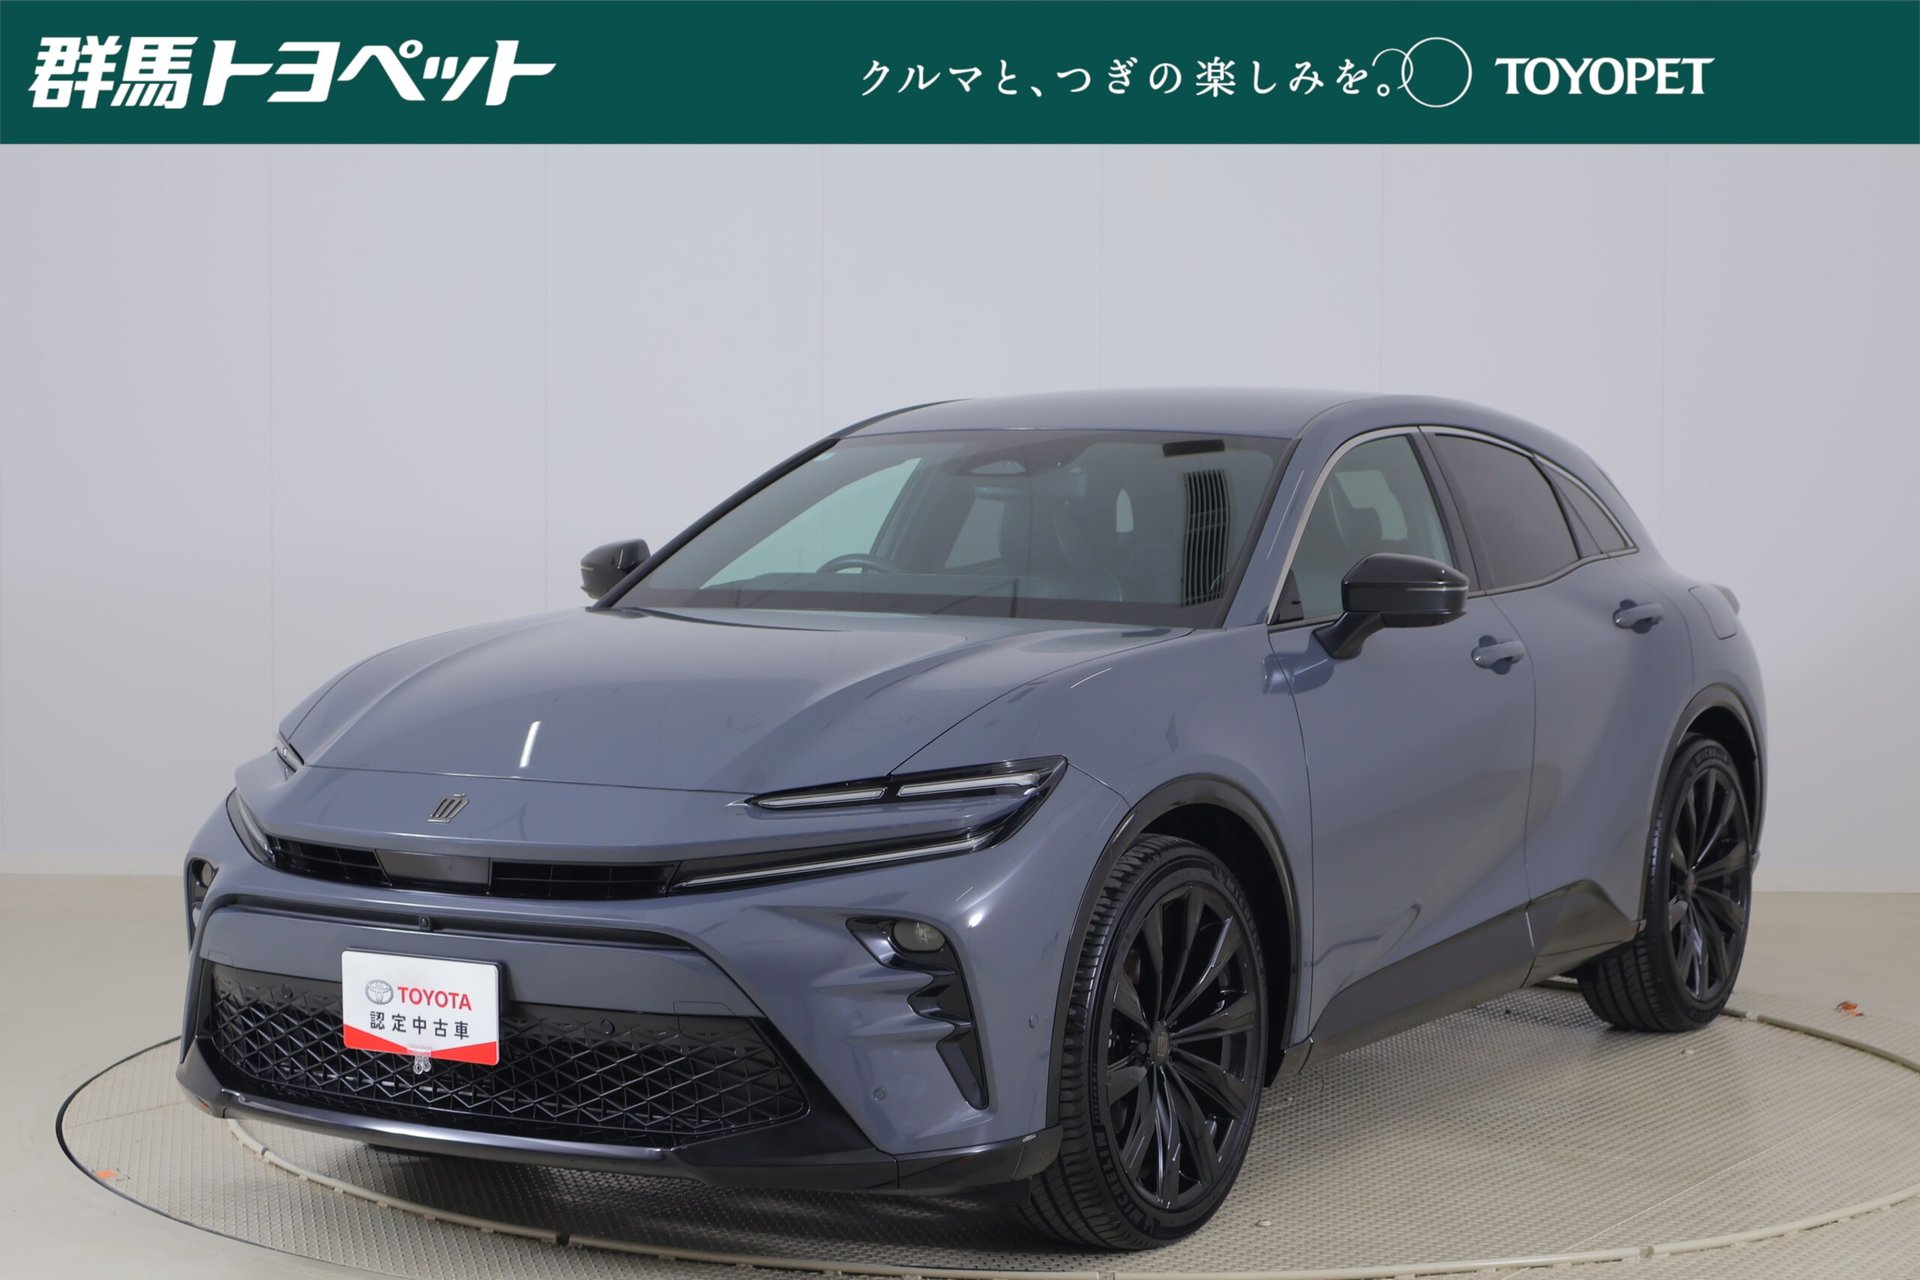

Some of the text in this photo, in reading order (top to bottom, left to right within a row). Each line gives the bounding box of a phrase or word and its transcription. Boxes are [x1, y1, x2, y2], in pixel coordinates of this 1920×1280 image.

[397, 986, 472, 1011] TOYOTA
[369, 1011, 470, 1040] 認定中古車
[1095, 1131, 1145, 1226] MICHELIN
